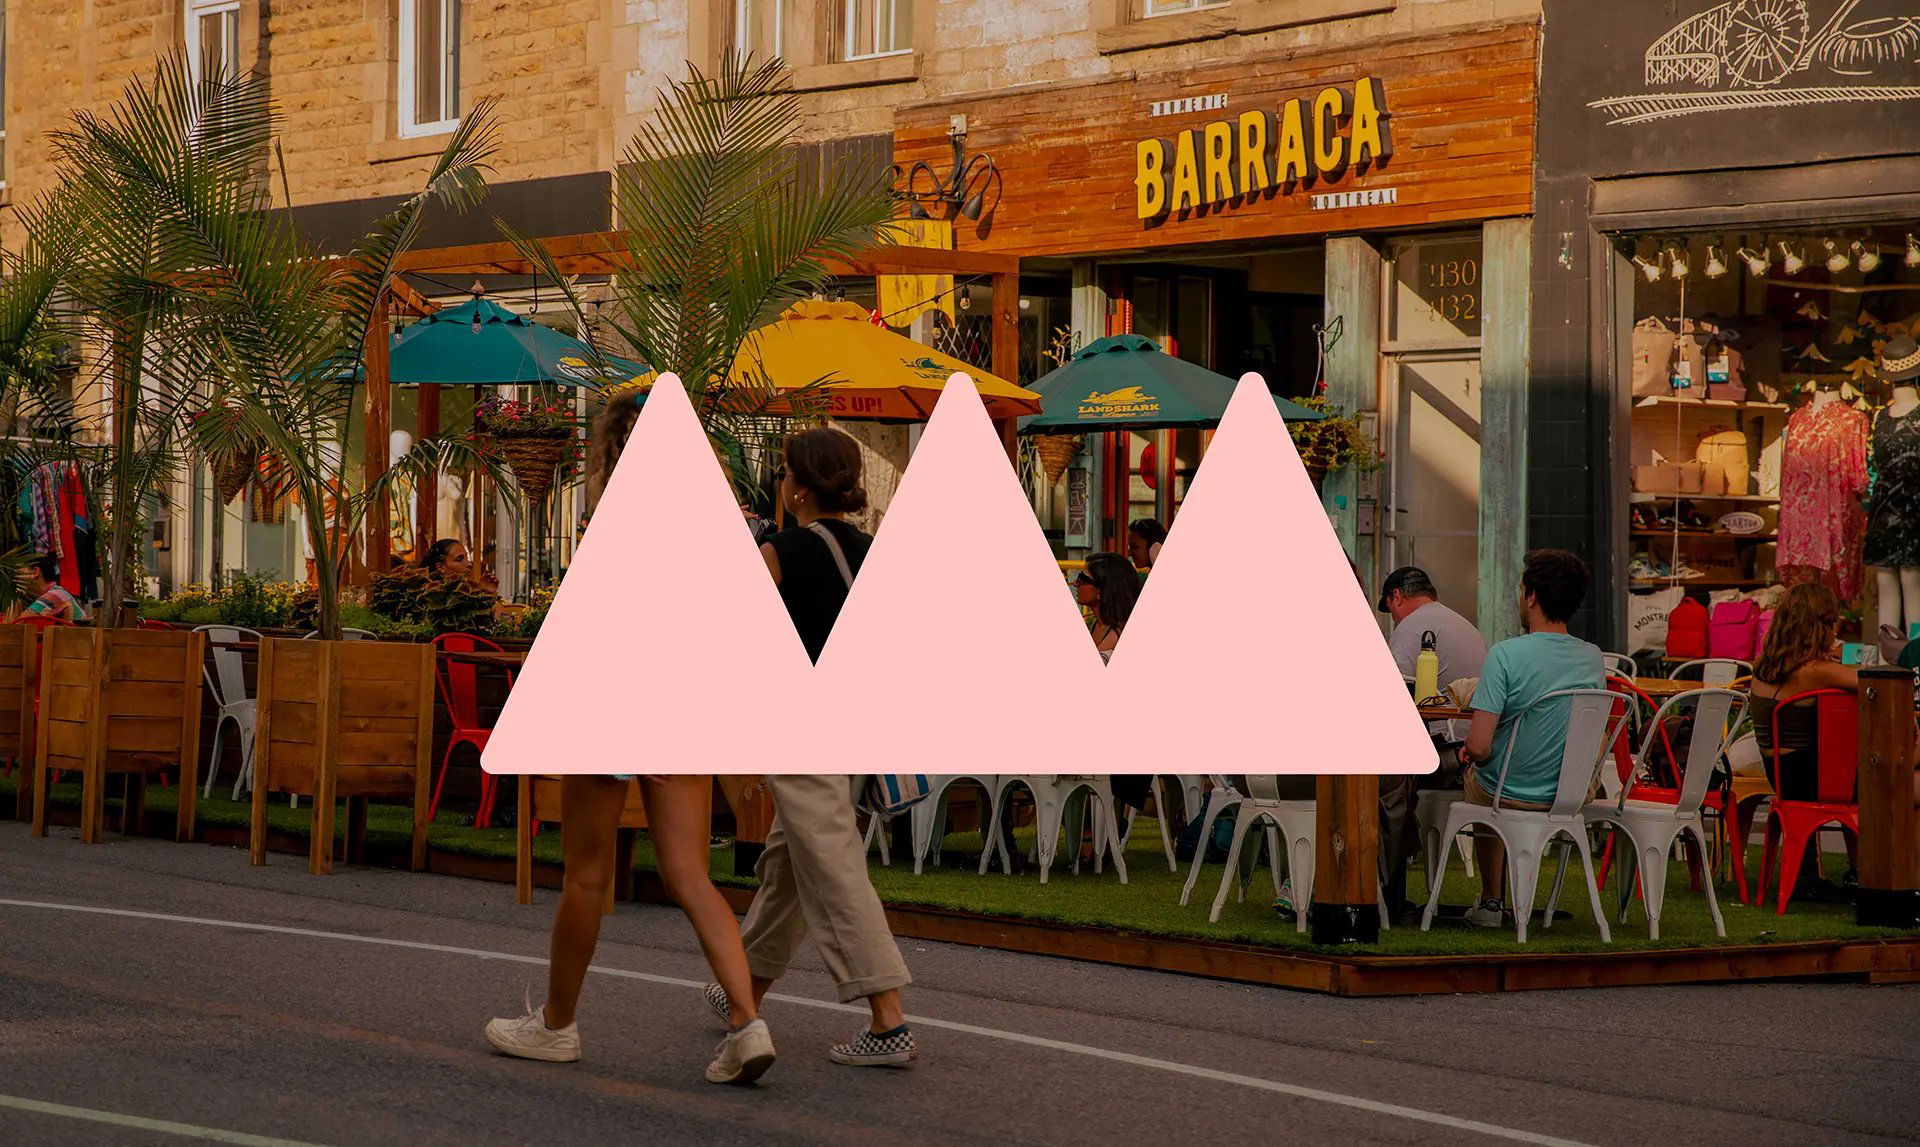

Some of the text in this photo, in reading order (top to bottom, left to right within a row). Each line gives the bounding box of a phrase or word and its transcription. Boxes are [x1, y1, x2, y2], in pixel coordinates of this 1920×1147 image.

[1149, 94, 1227, 116] RHUMERIE
[1134, 76, 1387, 223] BARRACA
[1311, 189, 1395, 210] MONTREAL
[851, 396, 884, 413] UP!
[1078, 403, 1160, 413] LANDSHARK
[1634, 612, 1669, 631] MONTRE
